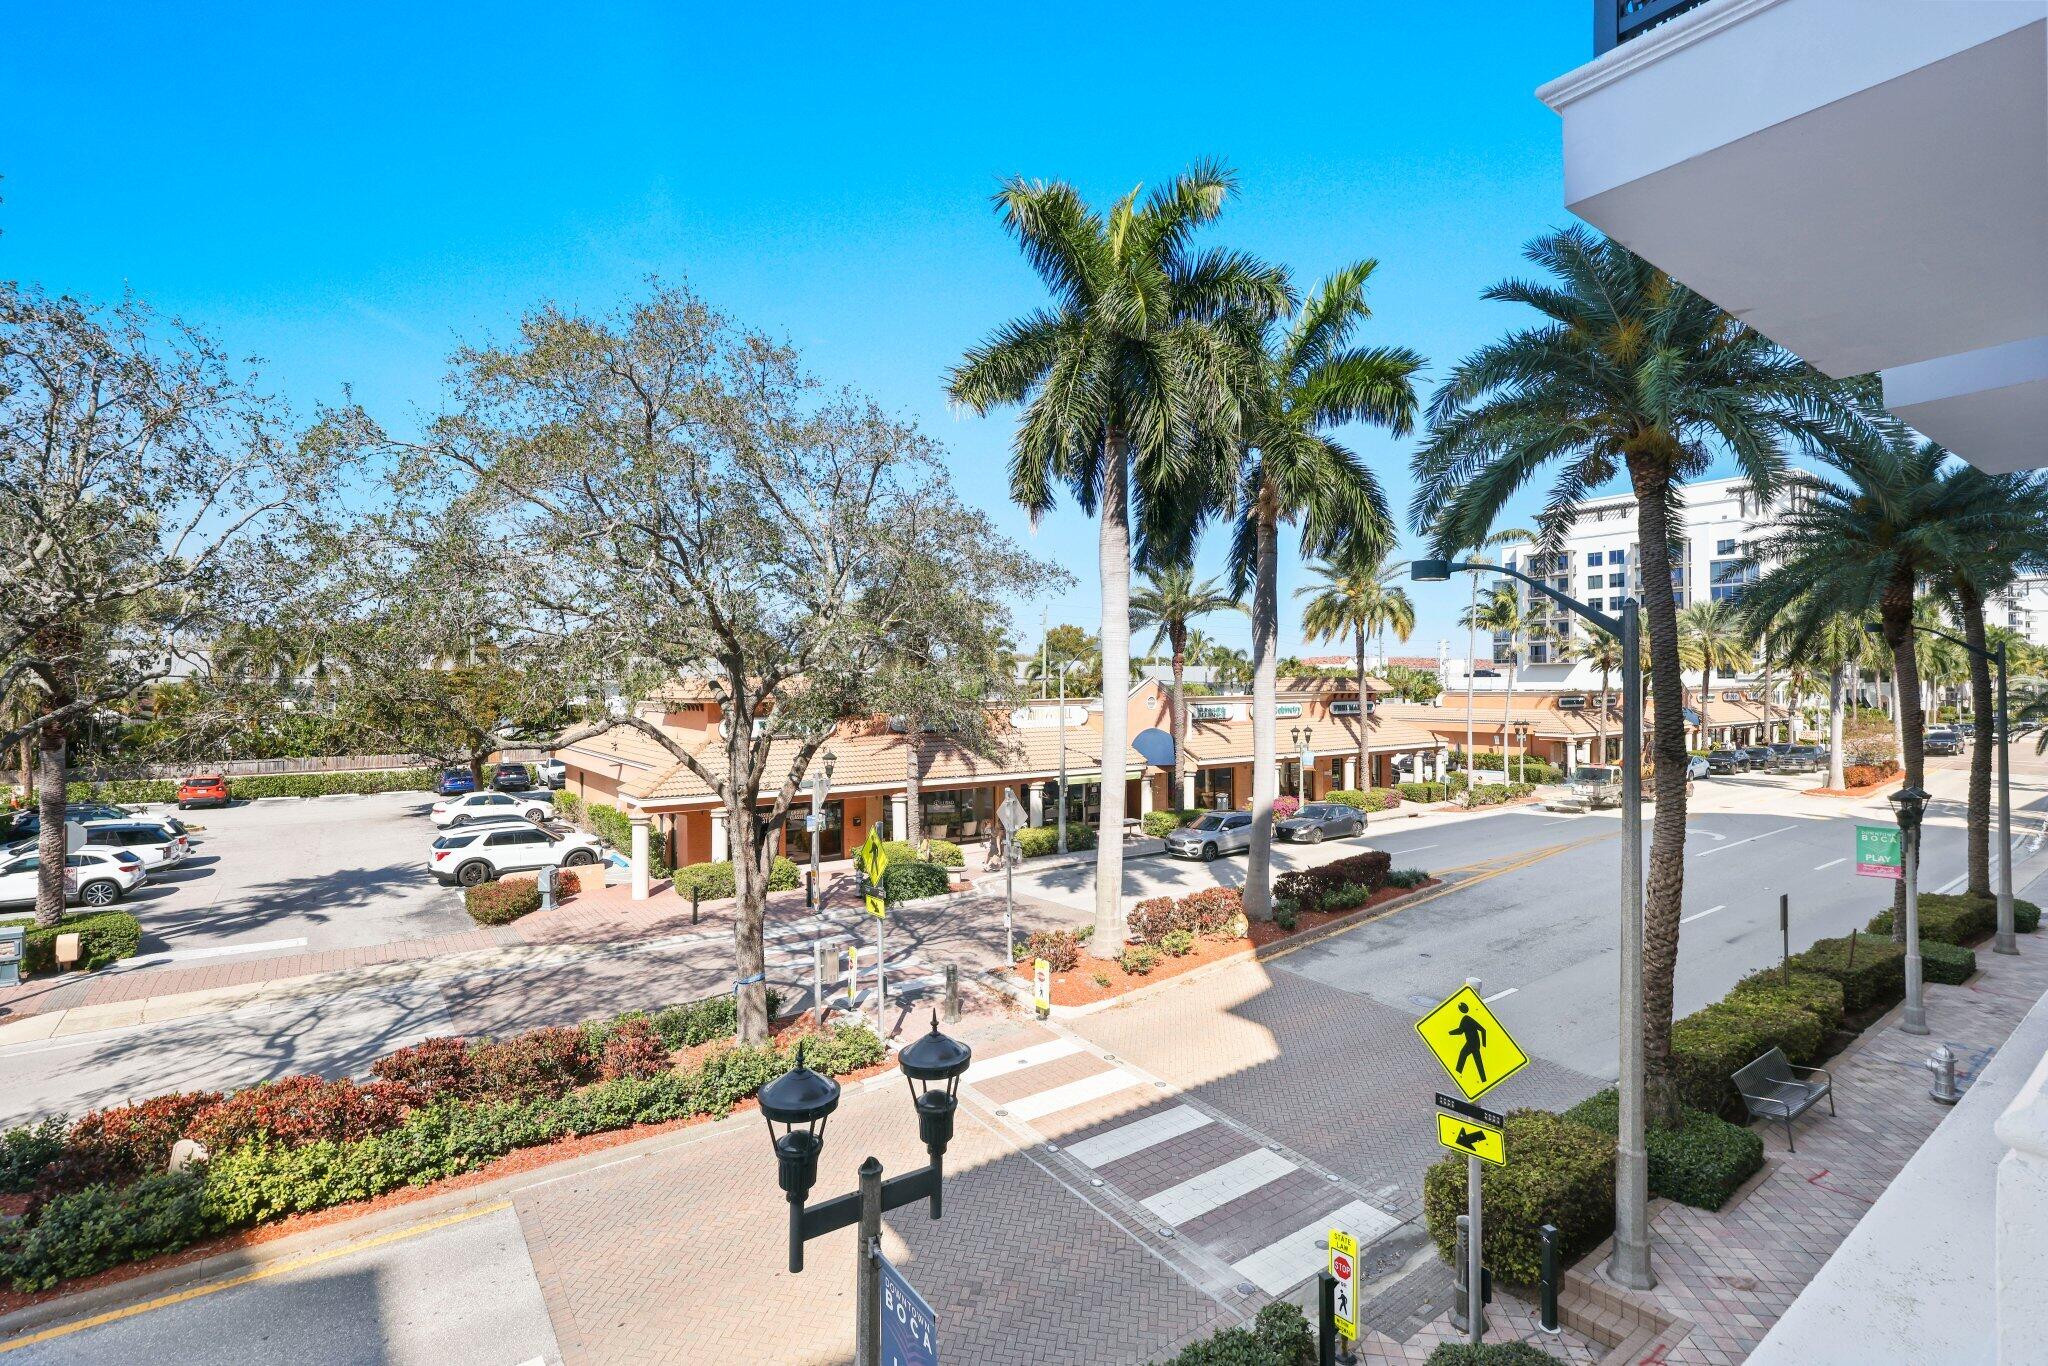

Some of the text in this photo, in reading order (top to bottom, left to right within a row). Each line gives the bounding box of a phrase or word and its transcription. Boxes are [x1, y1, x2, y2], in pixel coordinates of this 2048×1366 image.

[1861, 834, 1897, 843] BOCA
[1865, 854, 1892, 863] PLAY
[1334, 1232, 1352, 1246] STATE
[1336, 1241, 1349, 1251] LAW
[1334, 1260, 1351, 1275] STOP
[885, 1277, 930, 1333] DOWNTOWN
[885, 1288, 933, 1355] BOCA
